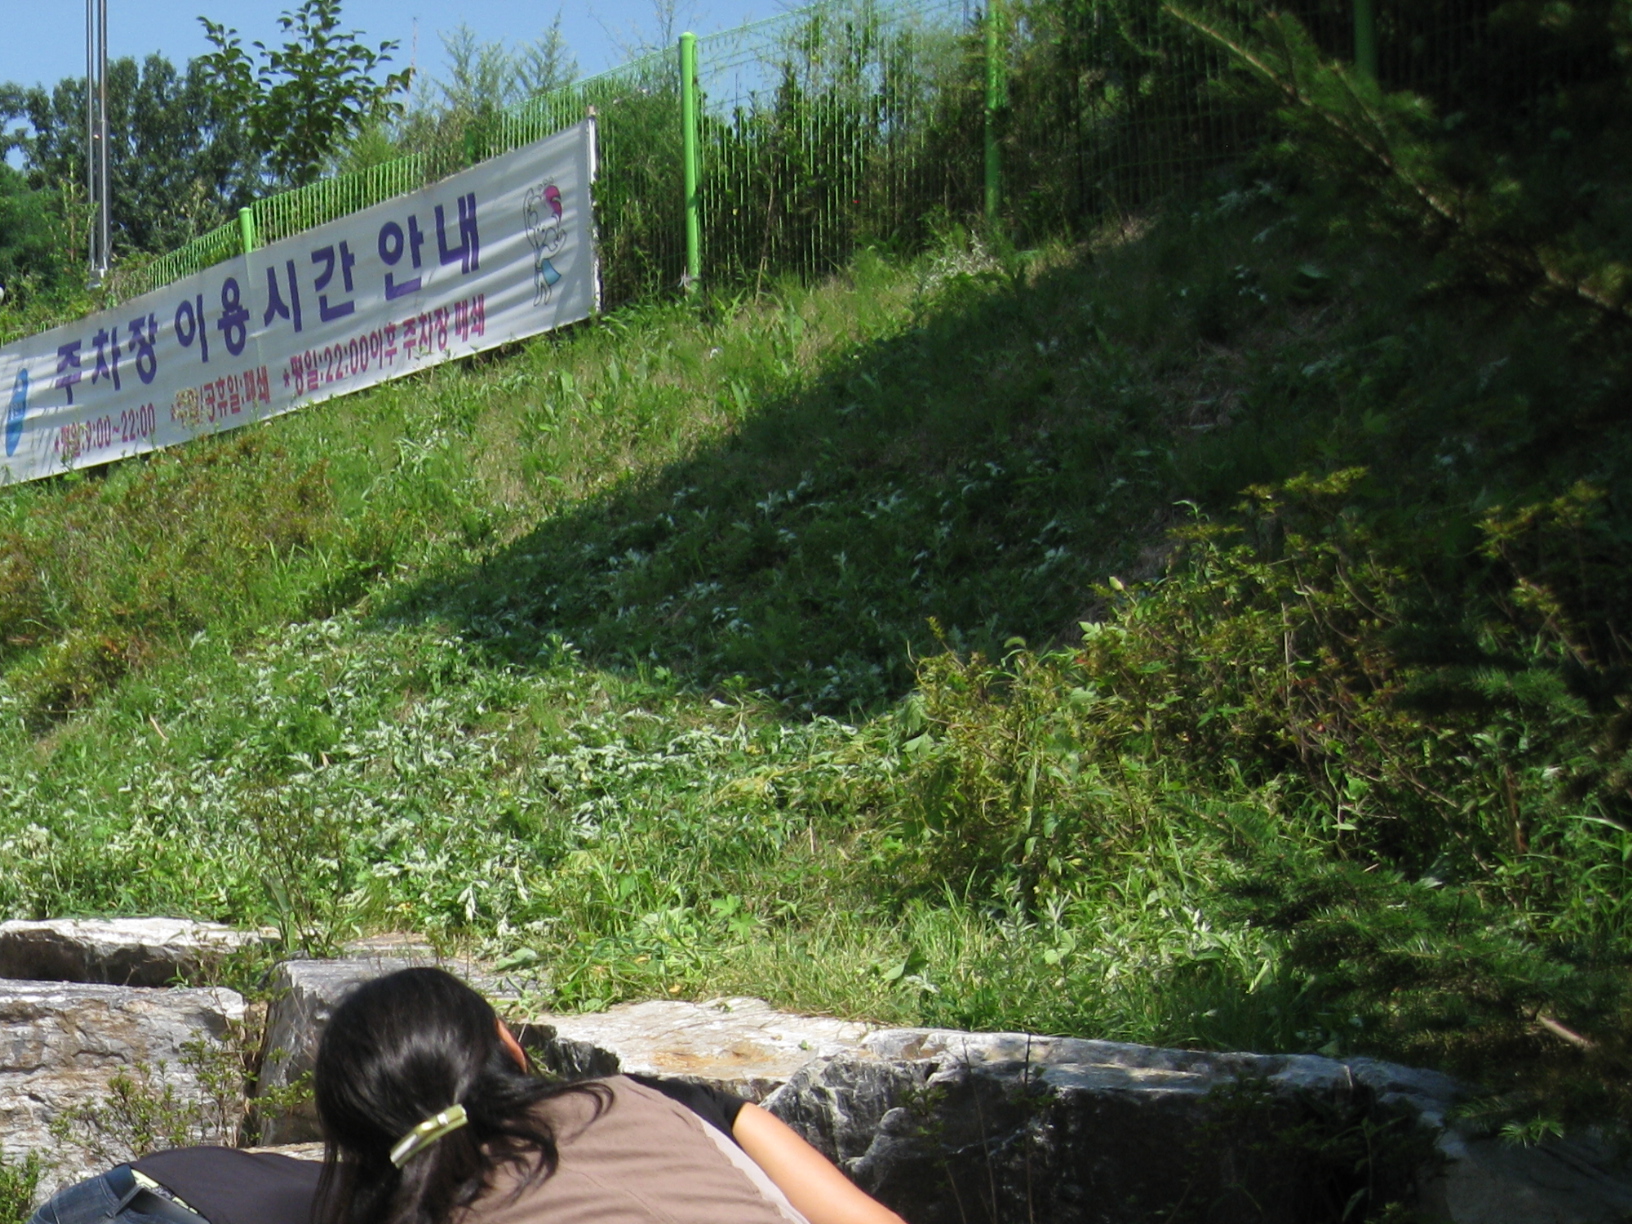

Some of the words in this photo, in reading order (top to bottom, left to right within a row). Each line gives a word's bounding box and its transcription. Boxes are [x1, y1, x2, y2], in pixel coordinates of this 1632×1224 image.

[55, 312, 158, 405] 주차장
[377, 192, 480, 301] 안내
[403, 306, 450, 360] 주차장
